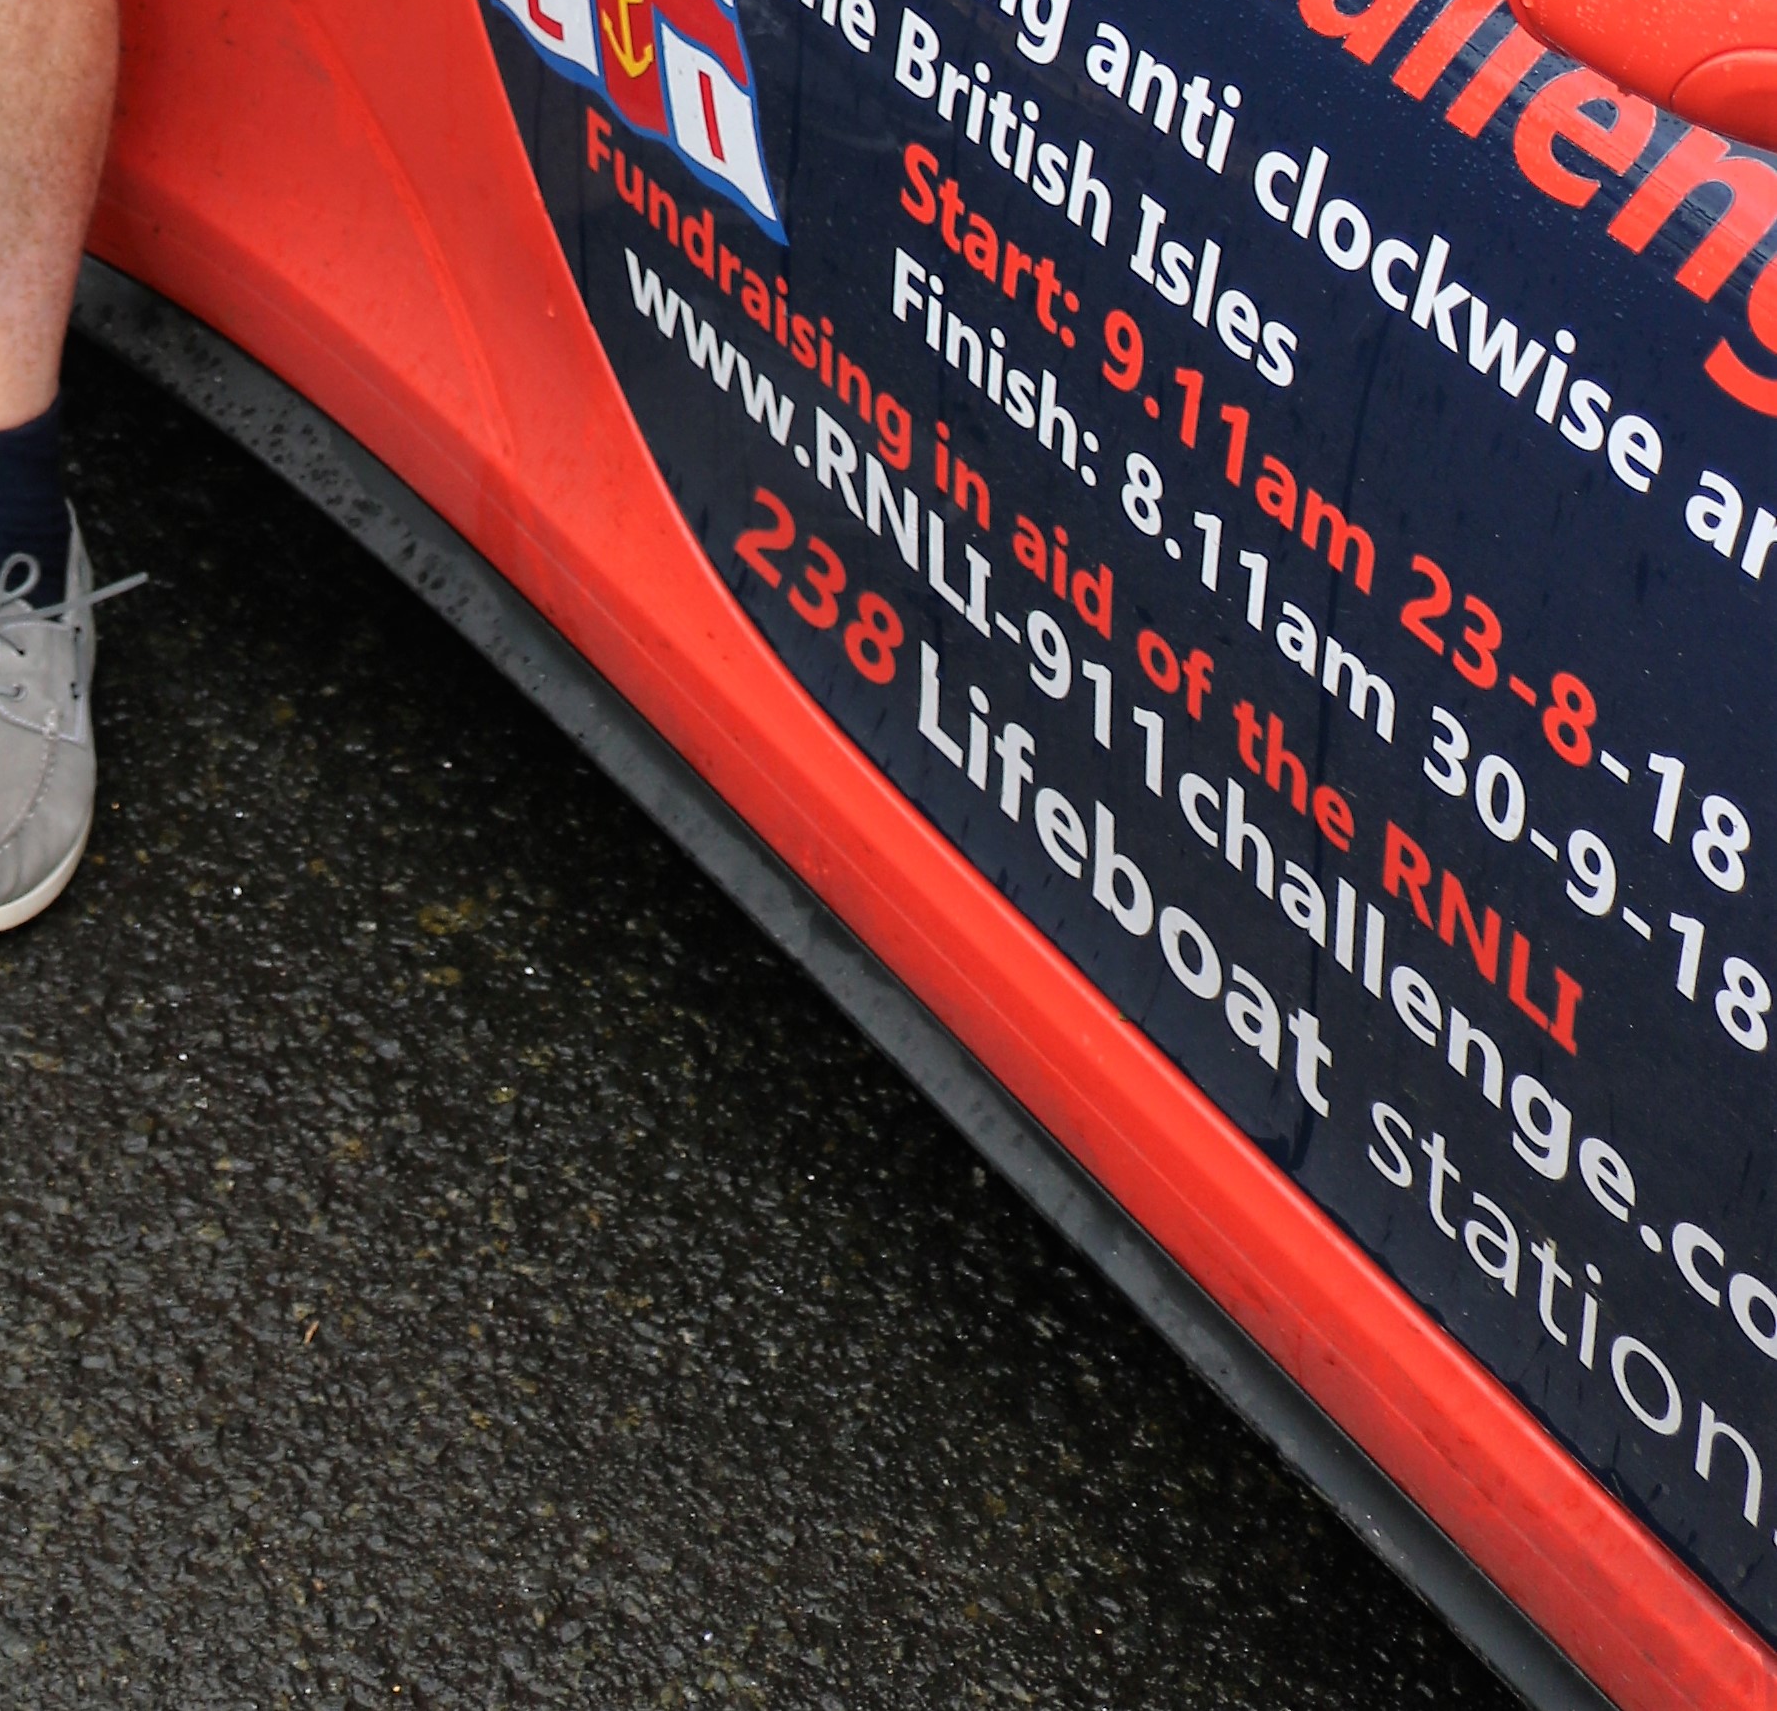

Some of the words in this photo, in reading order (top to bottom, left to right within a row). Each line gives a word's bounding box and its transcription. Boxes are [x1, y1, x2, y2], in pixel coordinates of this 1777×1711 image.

[894, 7, 1112, 246] British
[1129, 193, 1299, 387] Isles
[900, 142, 1080, 349] Start:
[1102, 309, 1376, 596] 9.11am
[1399, 553, 1751, 893] 23-8-18
[1085, 21, 1243, 175] anti
[1254, 146, 1663, 493] clockwise
[586, 106, 913, 471] Fundraising
[933, 422, 991, 531] in
[1012, 514, 1114, 641] aid
[1137, 628, 1214, 721] of
[1232, 699, 1356, 852] the
[1382, 819, 1583, 1057] RNLI
[733, 487, 905, 686] 238
[917, 639, 1333, 1118] Lifeboat
[892, 247, 1100, 487] Finish:
[1122, 452, 1396, 744] 8.11am
[1423, 705, 1771, 1052] 30-9-18
